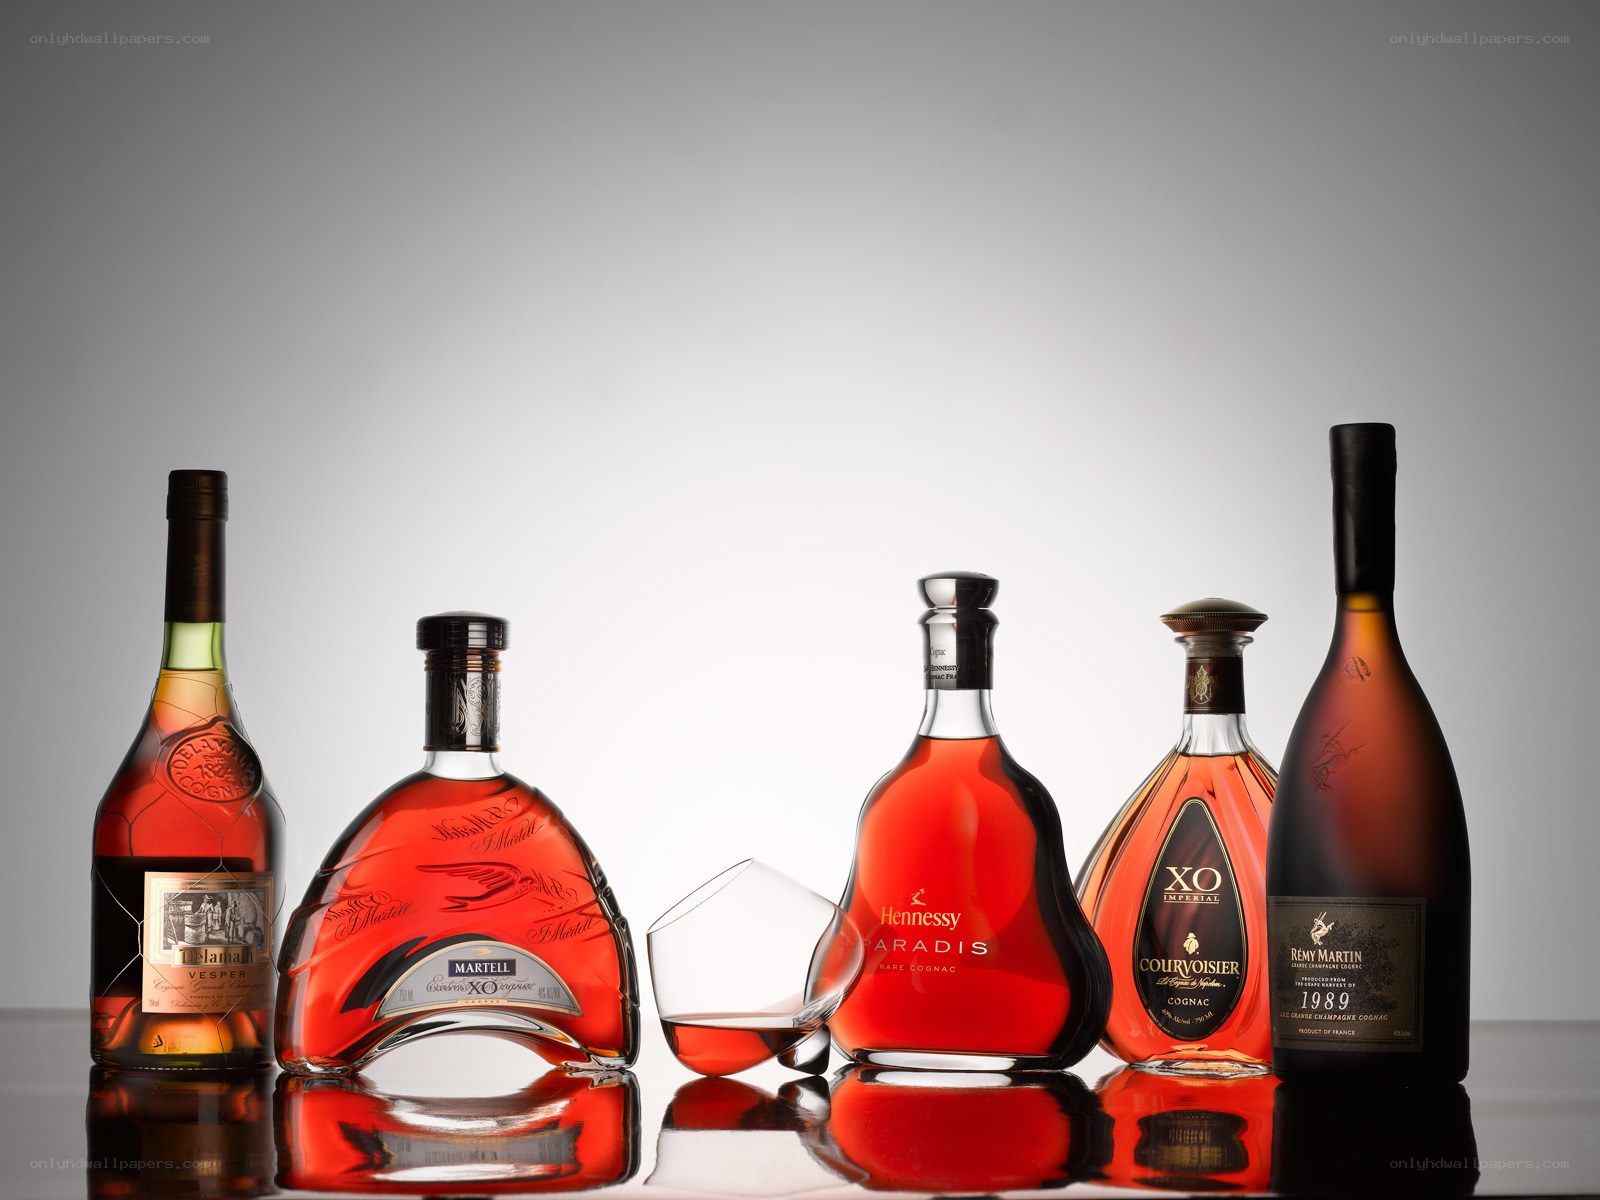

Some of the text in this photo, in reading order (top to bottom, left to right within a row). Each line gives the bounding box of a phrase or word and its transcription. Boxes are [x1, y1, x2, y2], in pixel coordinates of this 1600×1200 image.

[1164, 866, 1222, 892] XO
[1163, 894, 1220, 902] IMPERIAL
[880, 906, 961, 931] Hennessy
[179, 946, 254, 964] Delamain
[1291, 947, 1362, 963] RÉMY MARTIN
[455, 962, 510, 973] MARTELL
[909, 964, 956, 973] COGNAC
[1140, 958, 1240, 979] COURVOISIER
[188, 971, 246, 979] VESPER
[467, 981, 497, 995] XO
[1167, 997, 1210, 1006] COGNAC
[1301, 991, 1350, 1010] 1989
[1290, 1012, 1313, 1020] GRANDE
[1298, 1028, 1322, 1036] PRODUCT
